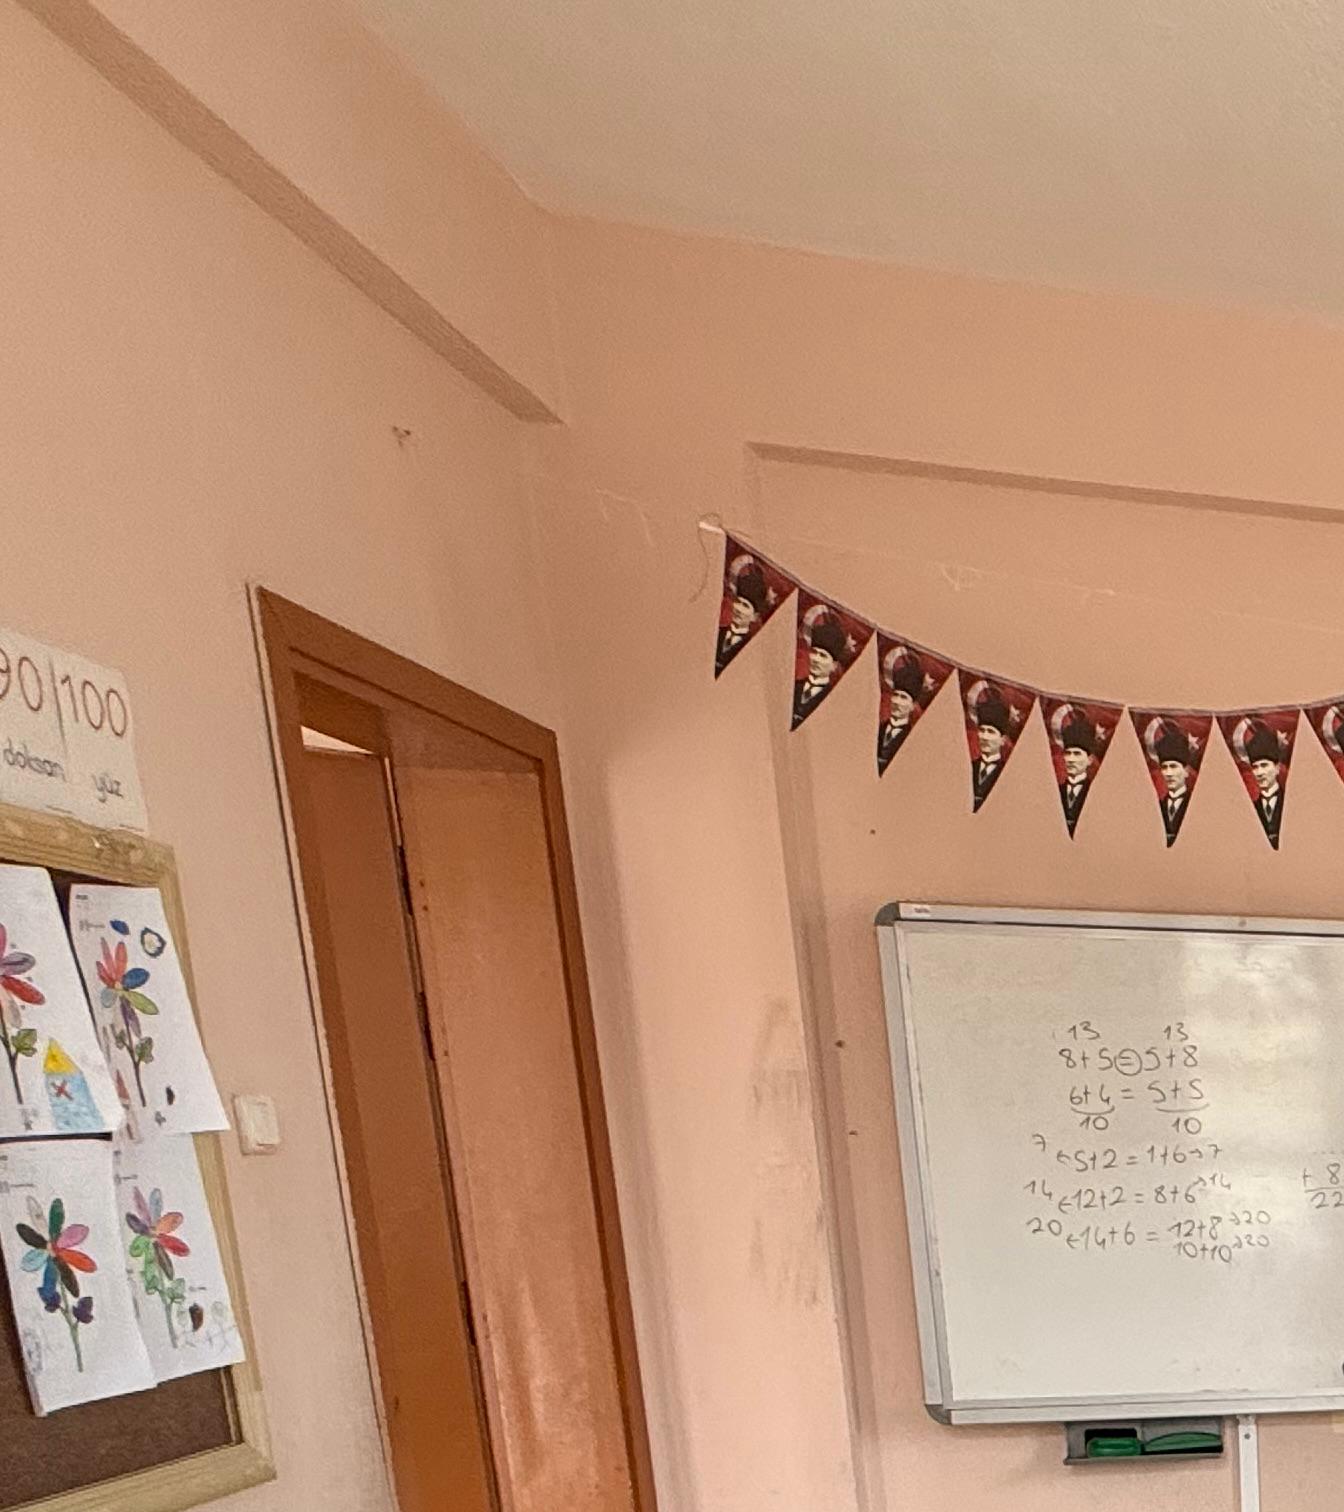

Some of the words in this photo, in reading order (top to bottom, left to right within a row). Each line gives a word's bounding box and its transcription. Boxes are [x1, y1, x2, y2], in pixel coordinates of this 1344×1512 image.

[61, 675, 127, 738] 100
[4, 737, 66, 783] doksan
[1067, 1020, 1100, 1041] 13
[1163, 1022, 1189, 1042] 13
[1079, 1115, 1109, 1131] 10
[1171, 1117, 1201, 1135] 10
[1031, 1133, 1046, 1152] 7
[1023, 1179, 1052, 1200] 14
[1026, 1217, 1062, 1236] 20
[1242, 1210, 1271, 1225] 20
[1246, 1234, 1270, 1248] 20
